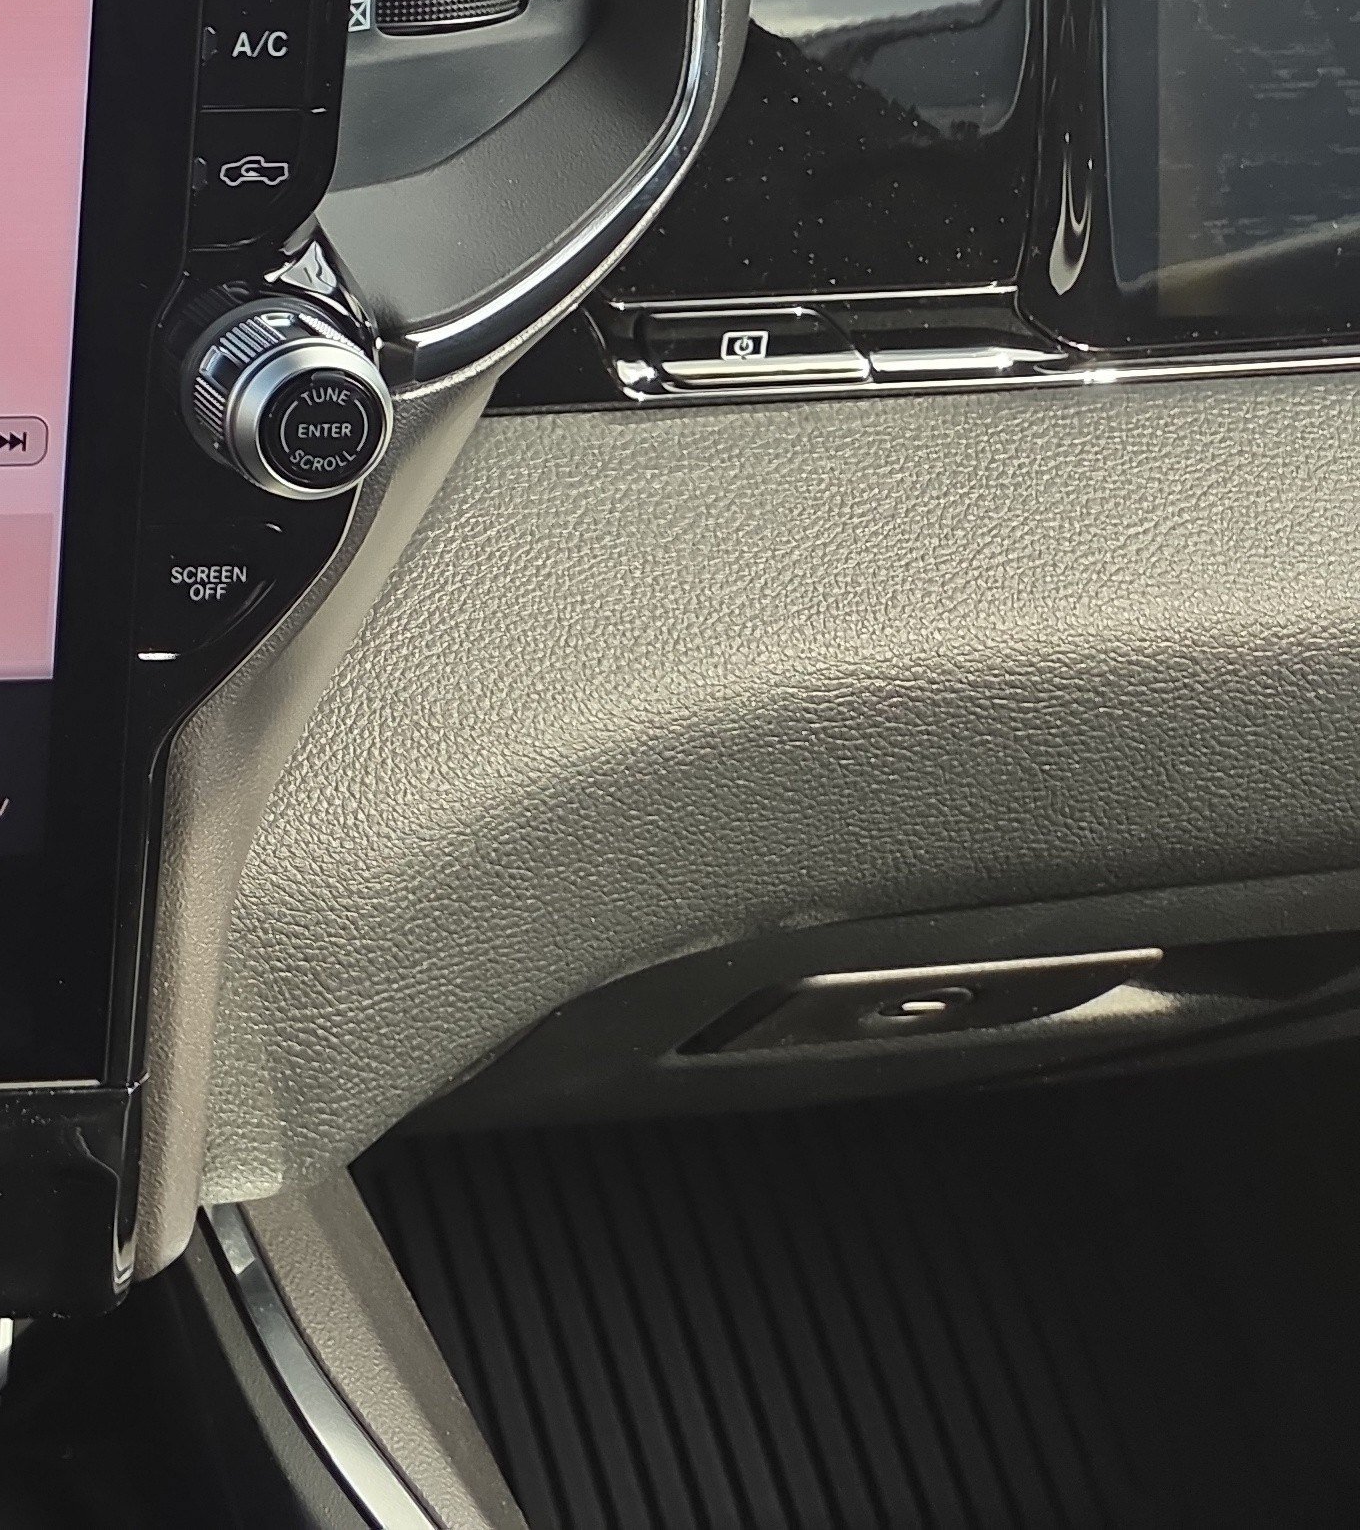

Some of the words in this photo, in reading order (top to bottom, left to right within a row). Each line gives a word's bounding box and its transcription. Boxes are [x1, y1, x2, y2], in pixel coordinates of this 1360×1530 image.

[232, 32, 289, 58] A/C
[302, 387, 352, 406] TUNE
[298, 423, 352, 438] ENTER
[289, 450, 357, 471] SCROLL
[171, 567, 247, 583] SCREEN
[189, 584, 227, 600] OFF
